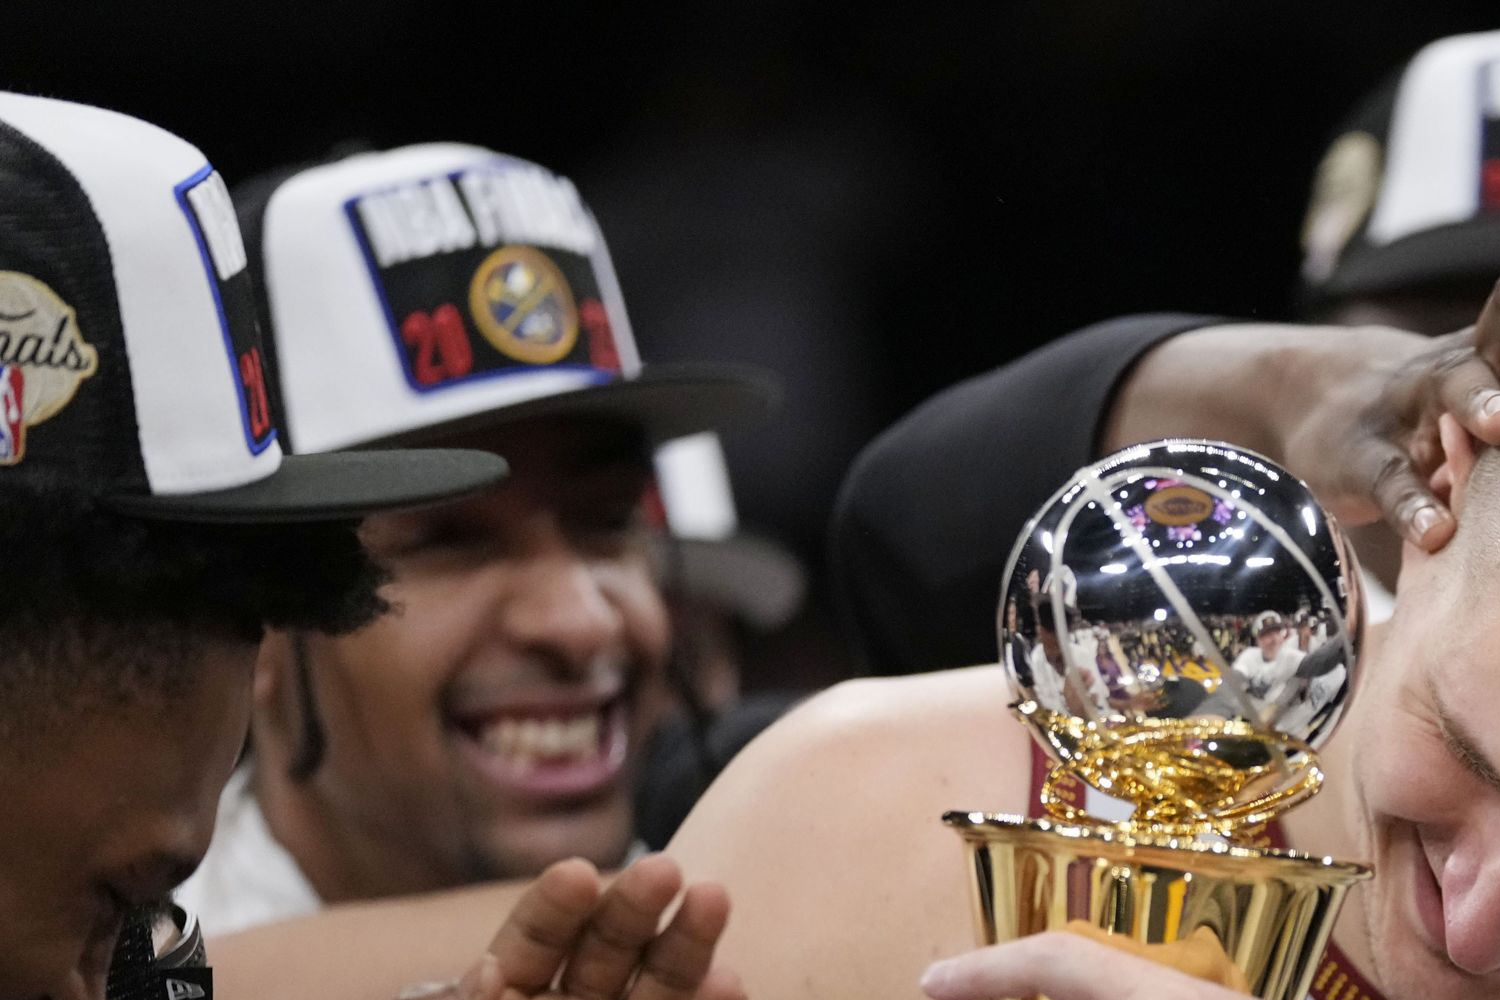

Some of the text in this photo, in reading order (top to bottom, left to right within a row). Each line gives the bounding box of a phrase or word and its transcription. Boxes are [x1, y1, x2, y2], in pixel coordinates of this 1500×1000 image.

[358, 176, 478, 269] NBA
[0, 313, 91, 371] nals
[401, 302, 474, 377] 20
